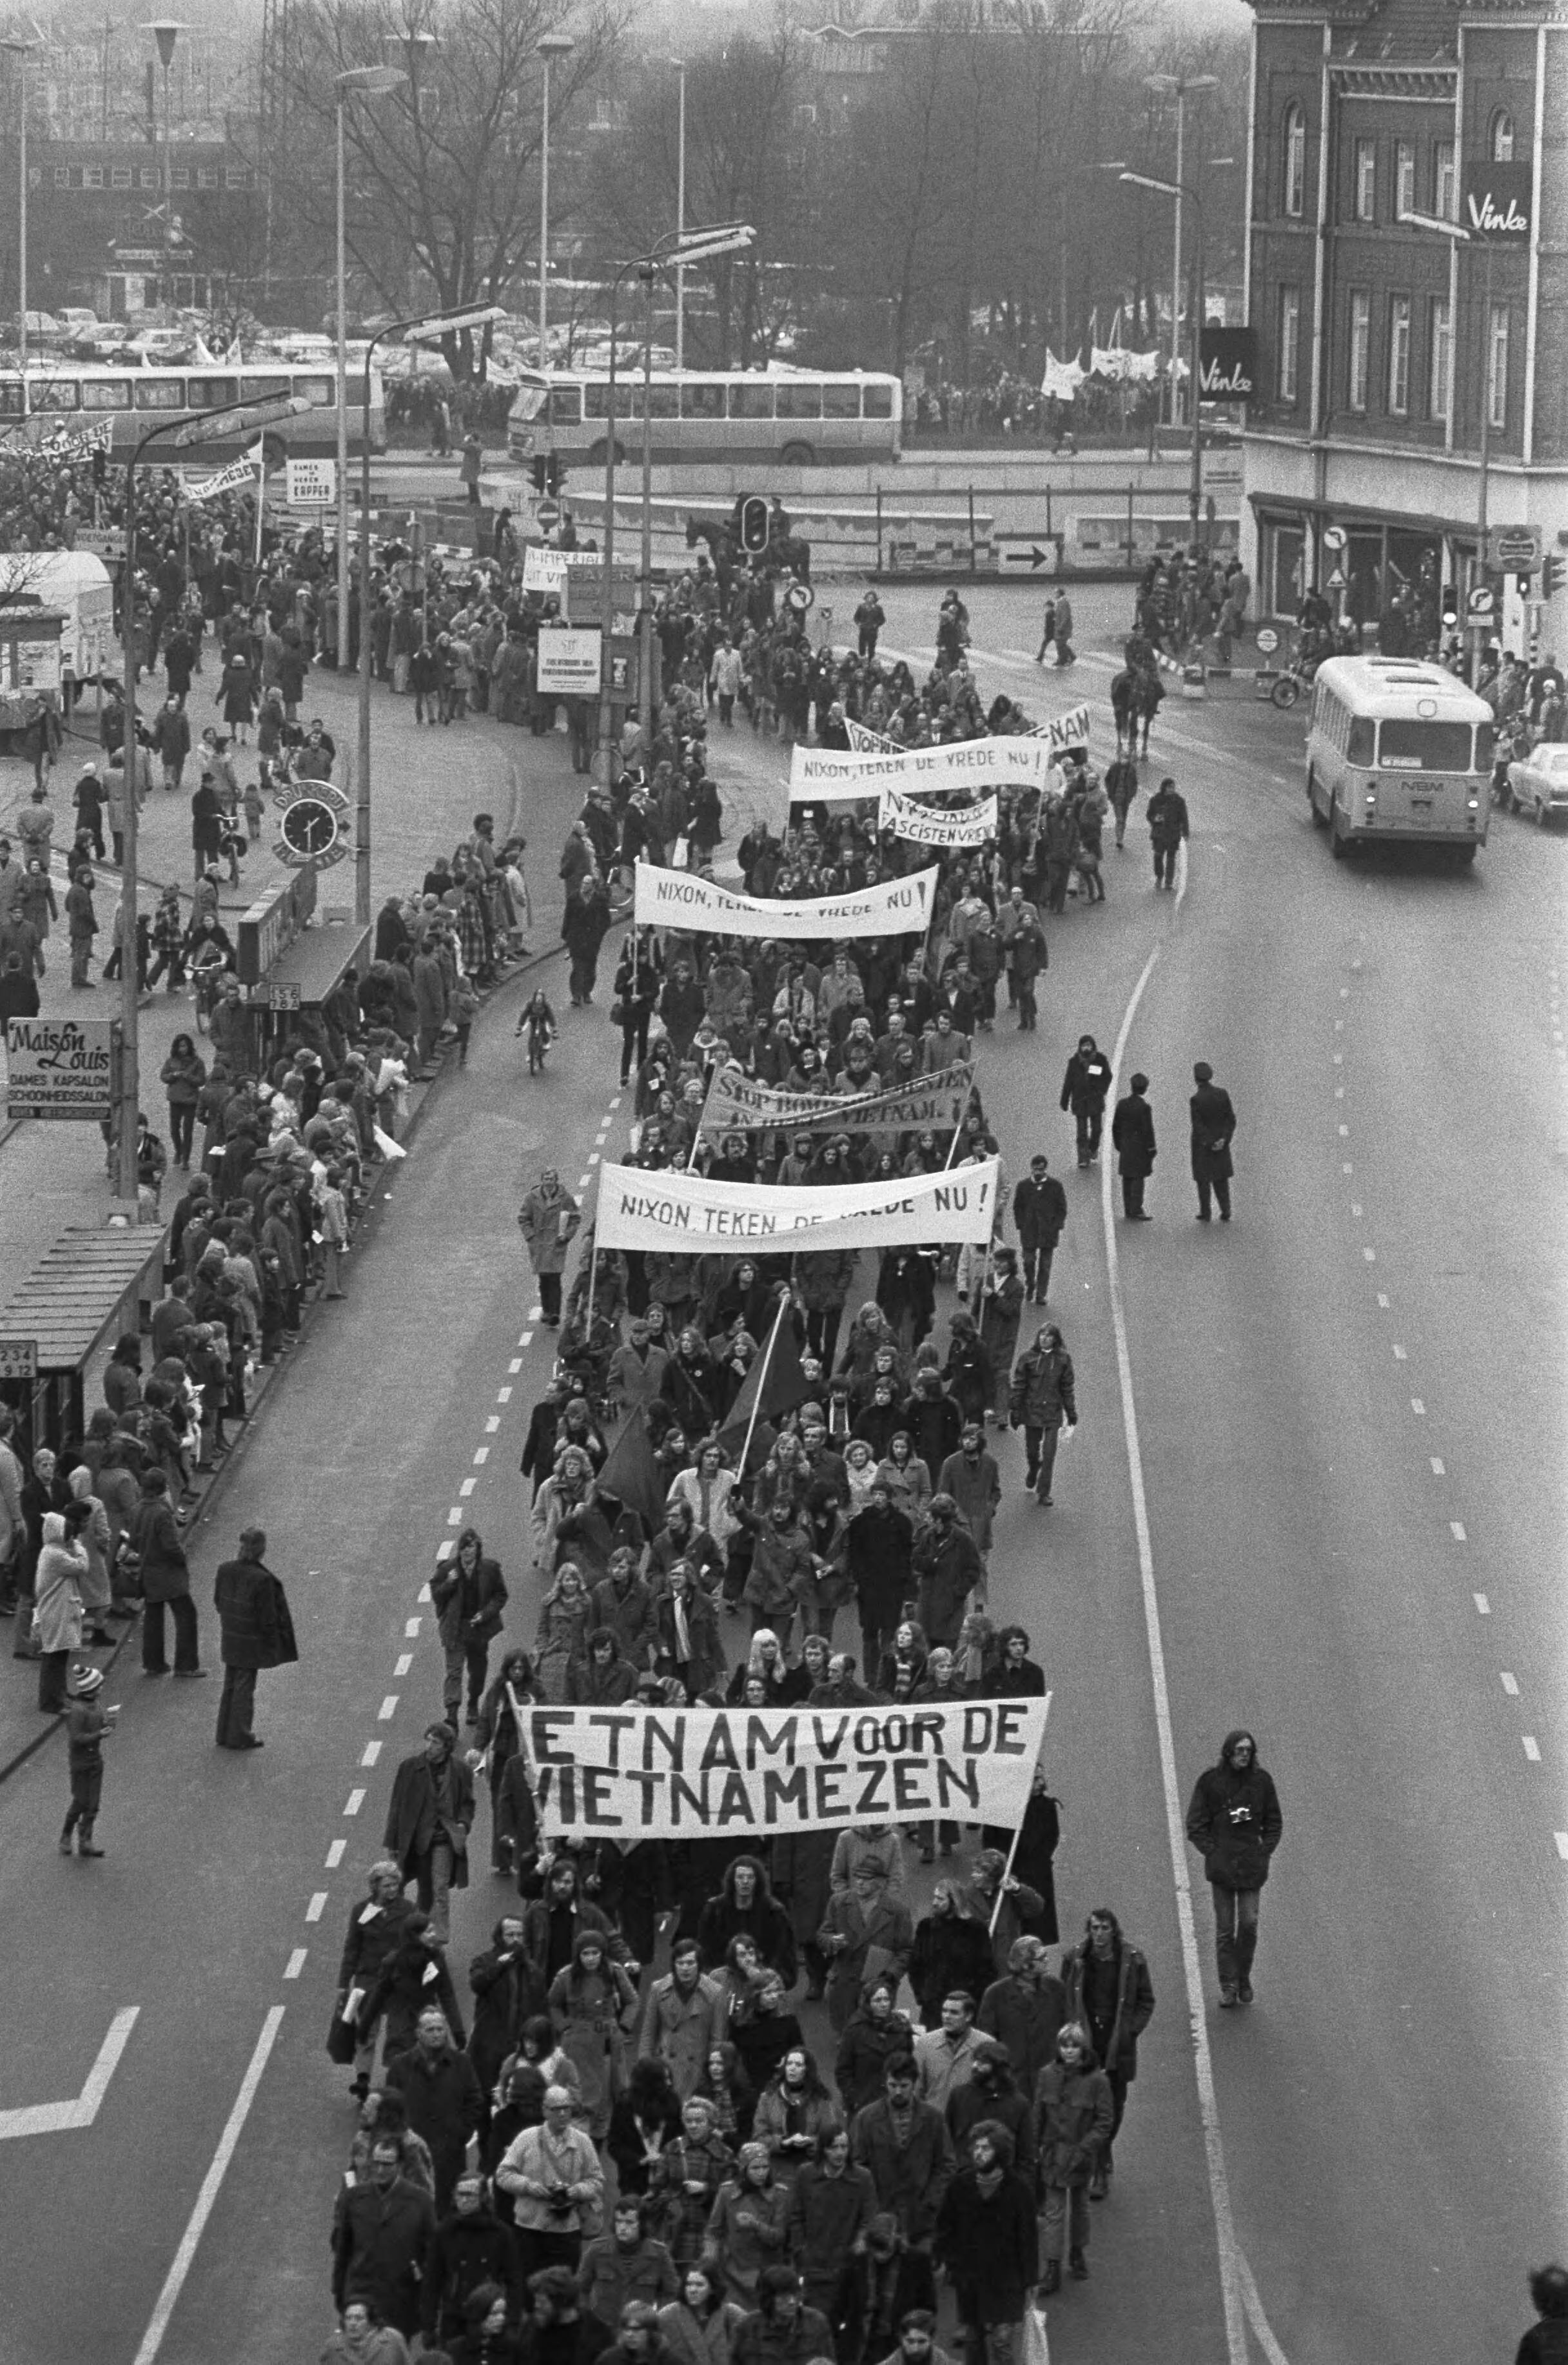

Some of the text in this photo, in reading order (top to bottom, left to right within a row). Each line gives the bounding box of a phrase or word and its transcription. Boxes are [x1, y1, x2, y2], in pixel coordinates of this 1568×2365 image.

[1469, 193, 1527, 231] Vinke
[1200, 357, 1252, 391] Vinke
[294, 486, 329, 496] KAPPER
[916, 758, 933, 770] DE
[947, 751, 996, 767] VREDE
[9, 1023, 85, 1052] Maison
[10, 1074, 109, 1086] DAMES KAPSALON
[705, 1208, 776, 1236] TEKEN
[12, 1349, 20, 1362] 3
[23, 1350, 31, 1360] 4
[19, 1365, 32, 1377] 12
[812, 1711, 946, 1759] VOOR
[963, 1704, 1028, 1755] DE
